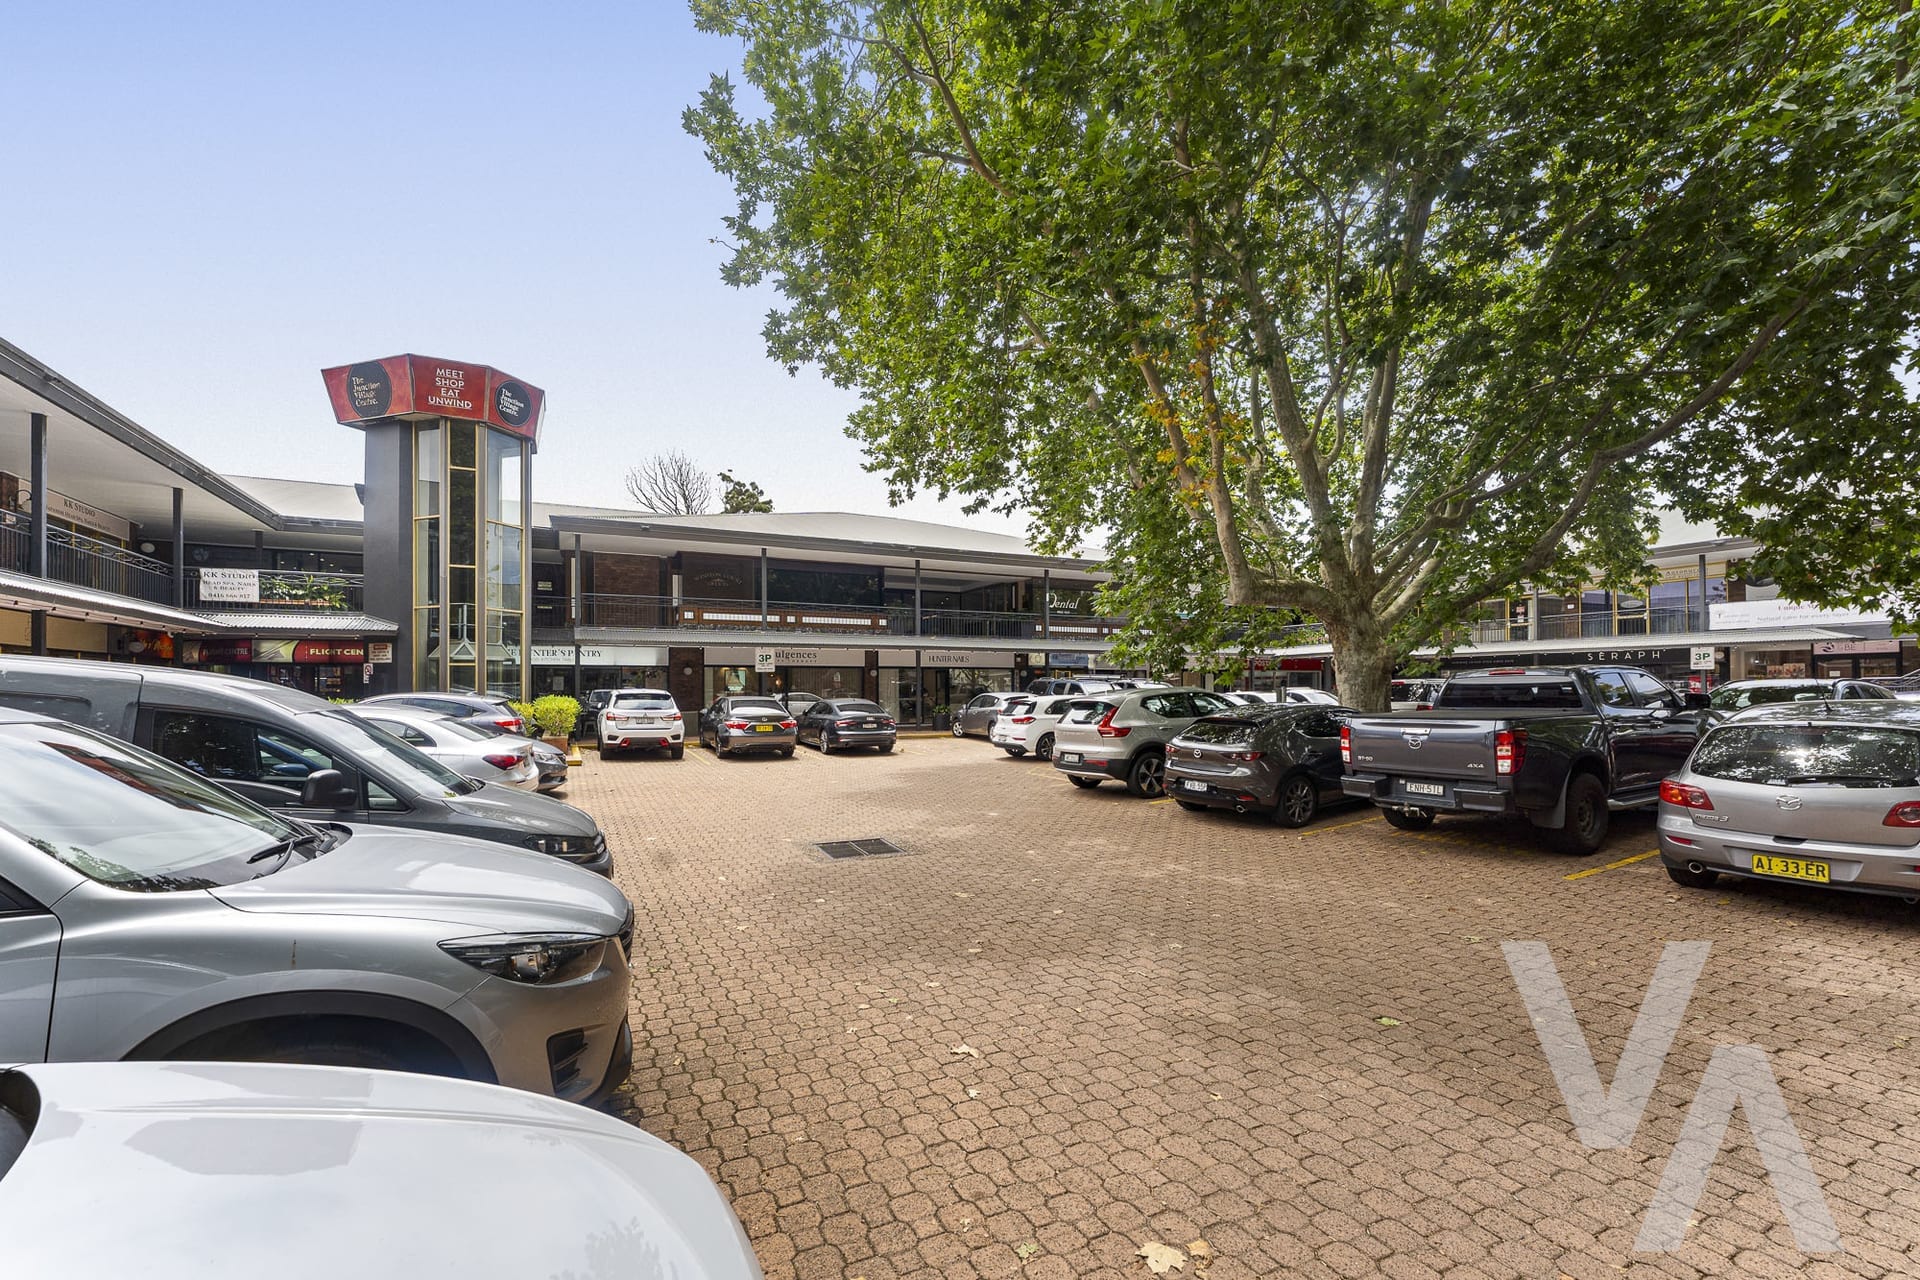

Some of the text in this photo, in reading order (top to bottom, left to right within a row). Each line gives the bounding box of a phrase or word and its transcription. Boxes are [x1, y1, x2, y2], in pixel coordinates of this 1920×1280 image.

[436, 368, 464, 378] MEET
[352, 377, 364, 385] The
[435, 377, 465, 388] SHOP
[353, 382, 380, 392] Junction
[354, 390, 377, 399] Village
[441, 388, 460, 398] EAT
[501, 388, 512, 398] The
[428, 396, 472, 409] UNWIND
[500, 400, 519, 412] Village
[501, 394, 524, 408] Junction
[63, 498, 74, 510] KK
[74, 502, 96, 517] STUDIO
[1049, 592, 1080, 609] Dental
[343, 648, 364, 656] CEN
[523, 648, 567, 657] NTER'S
[775, 650, 817, 659] ulgences
[1587, 650, 1660, 661] SERAPH
[1695, 652, 1711, 661] 3P
[758, 654, 772, 663] 3P
